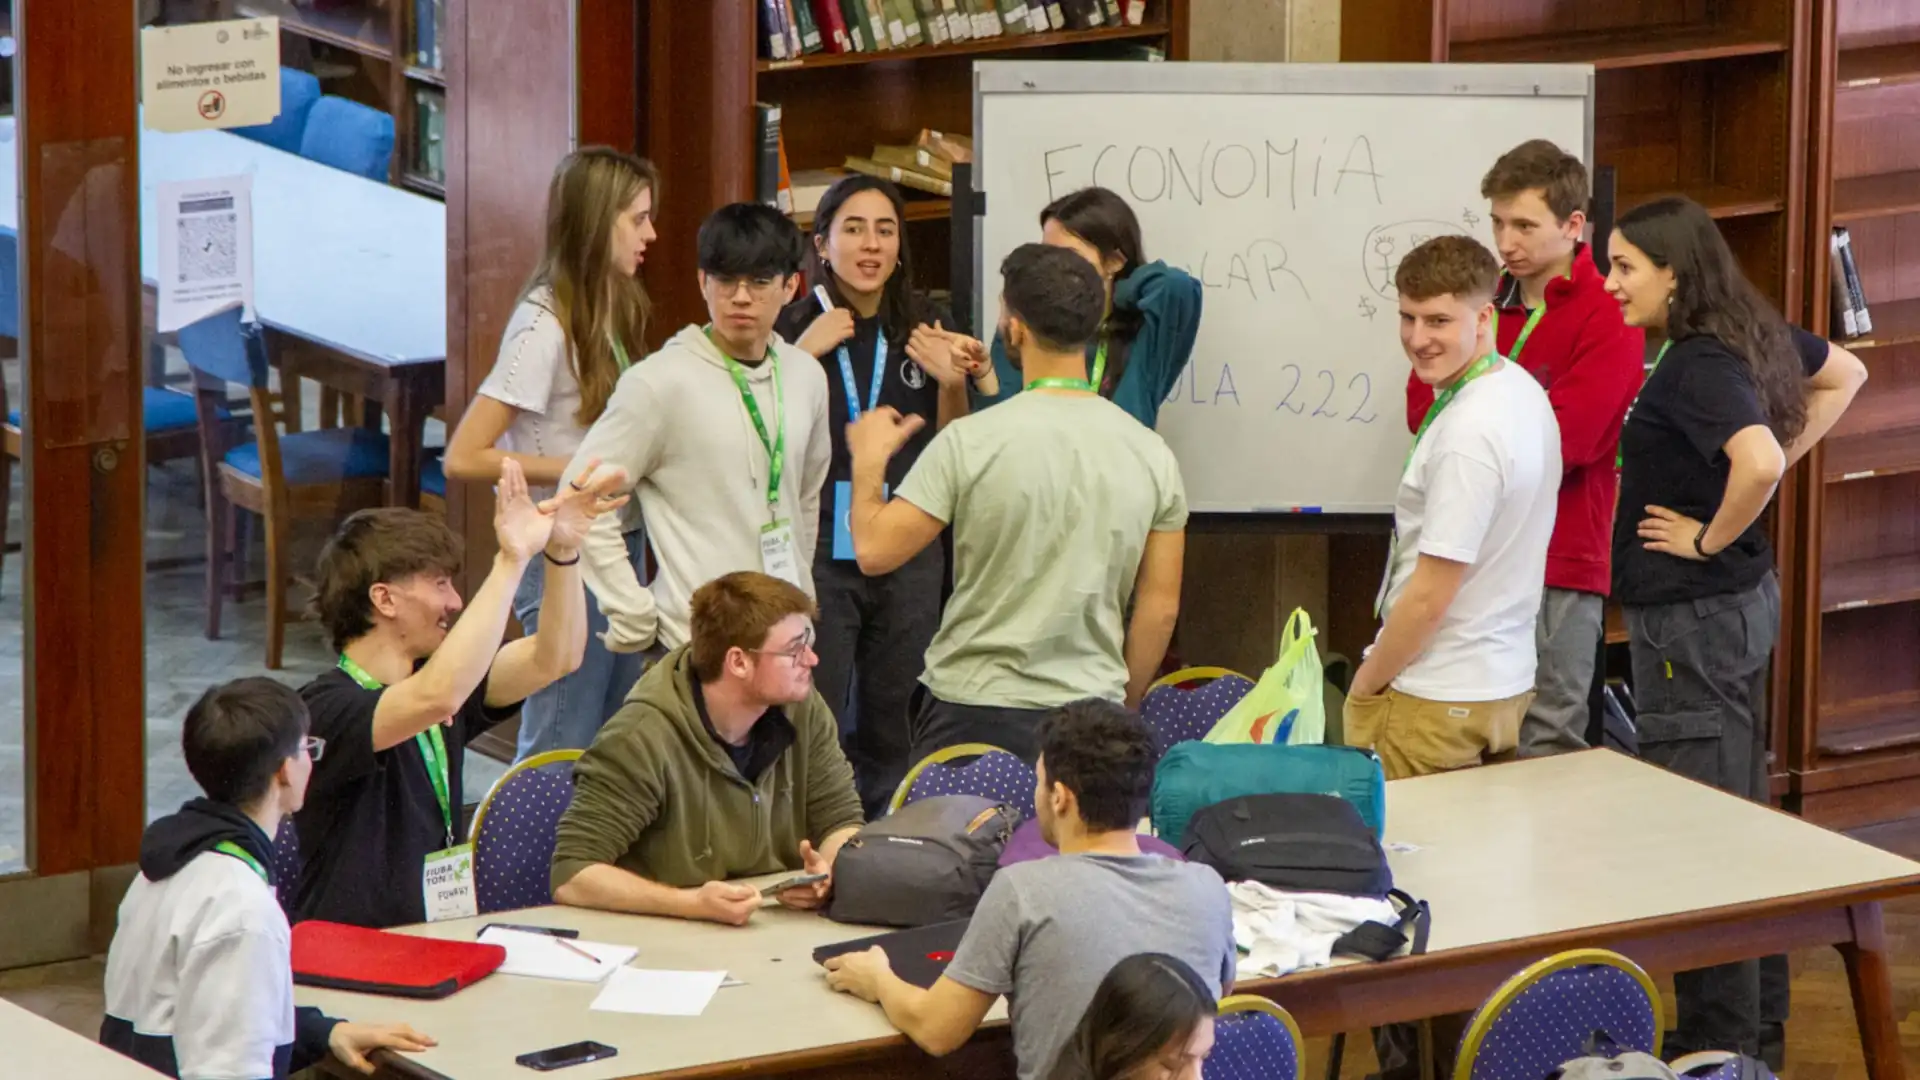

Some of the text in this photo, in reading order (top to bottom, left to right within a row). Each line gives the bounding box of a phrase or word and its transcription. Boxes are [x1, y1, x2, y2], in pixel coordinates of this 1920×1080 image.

[167, 59, 255, 76] No ingresar con
[157, 71, 266, 90] alimentos o bebidas
[1186, 238, 1311, 301] LAR
[1276, 364, 1378, 424] 222
[426, 864, 453, 876] FIUBA
[426, 875, 446, 886] TON
